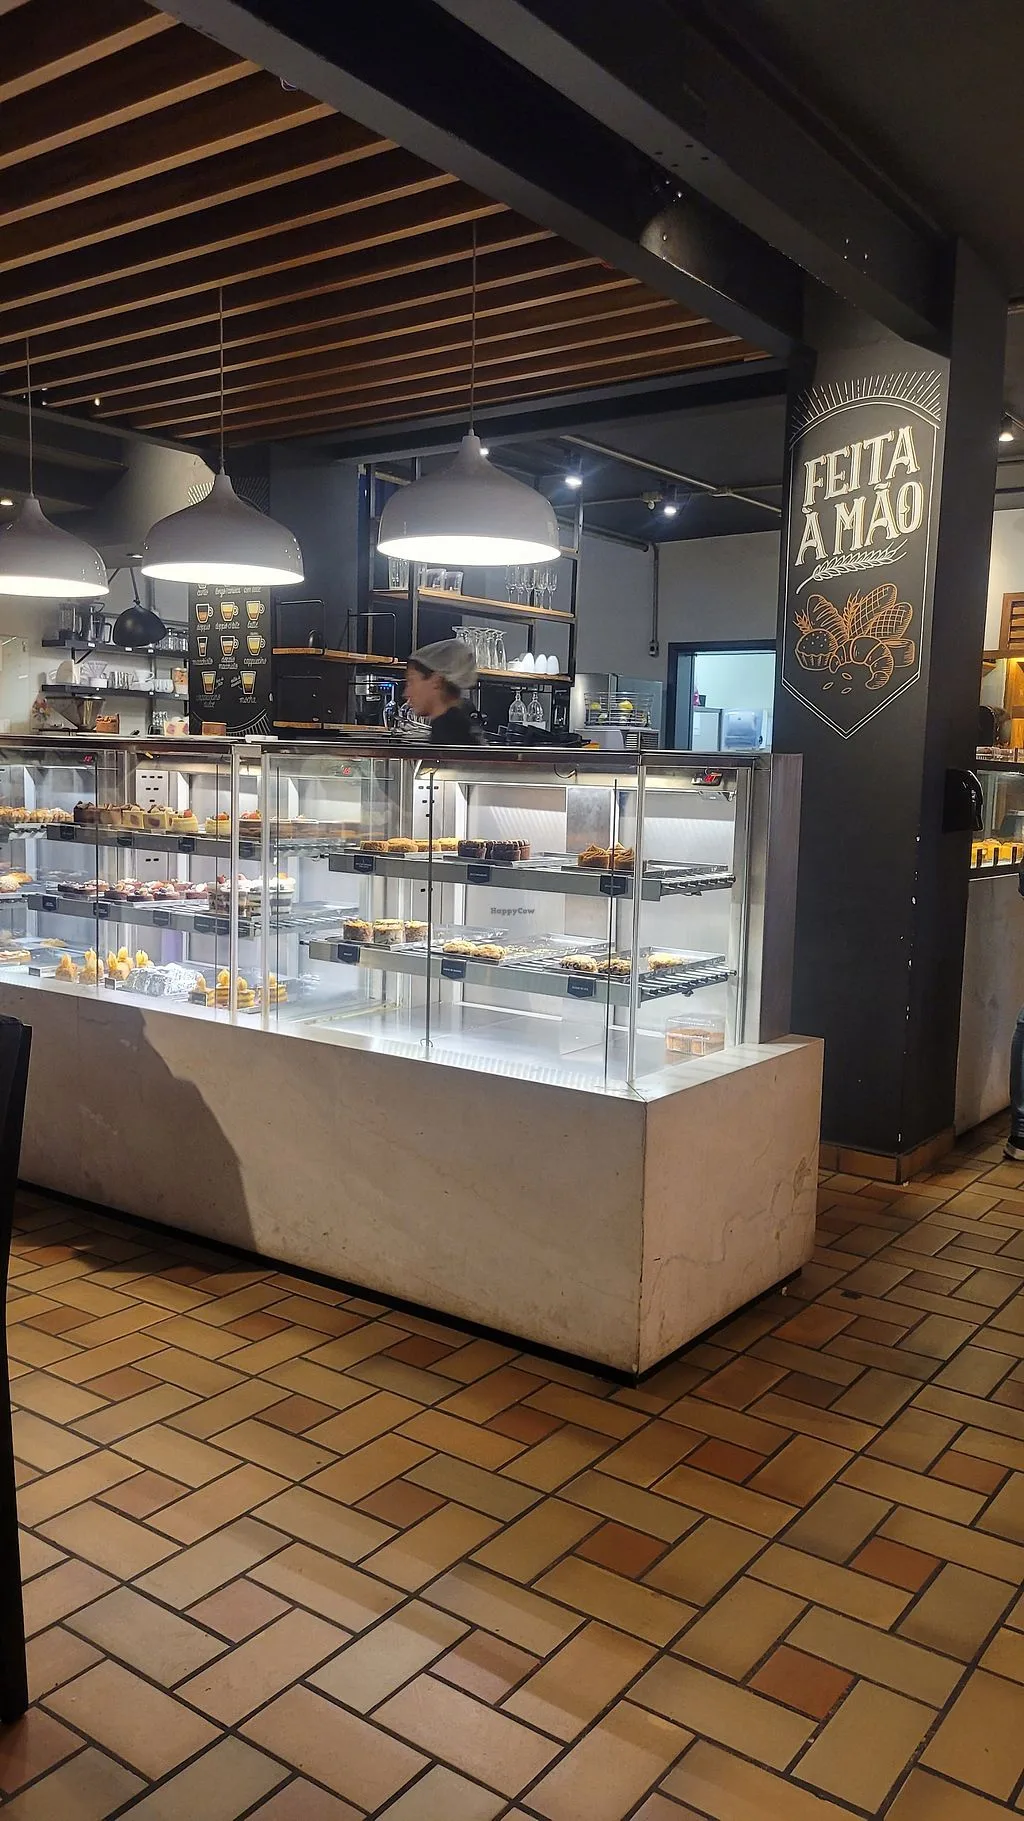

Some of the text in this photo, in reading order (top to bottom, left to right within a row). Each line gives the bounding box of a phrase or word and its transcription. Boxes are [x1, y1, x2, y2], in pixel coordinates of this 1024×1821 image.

[803, 425, 920, 508] FEITA
[795, 481, 924, 566] À MÃO
